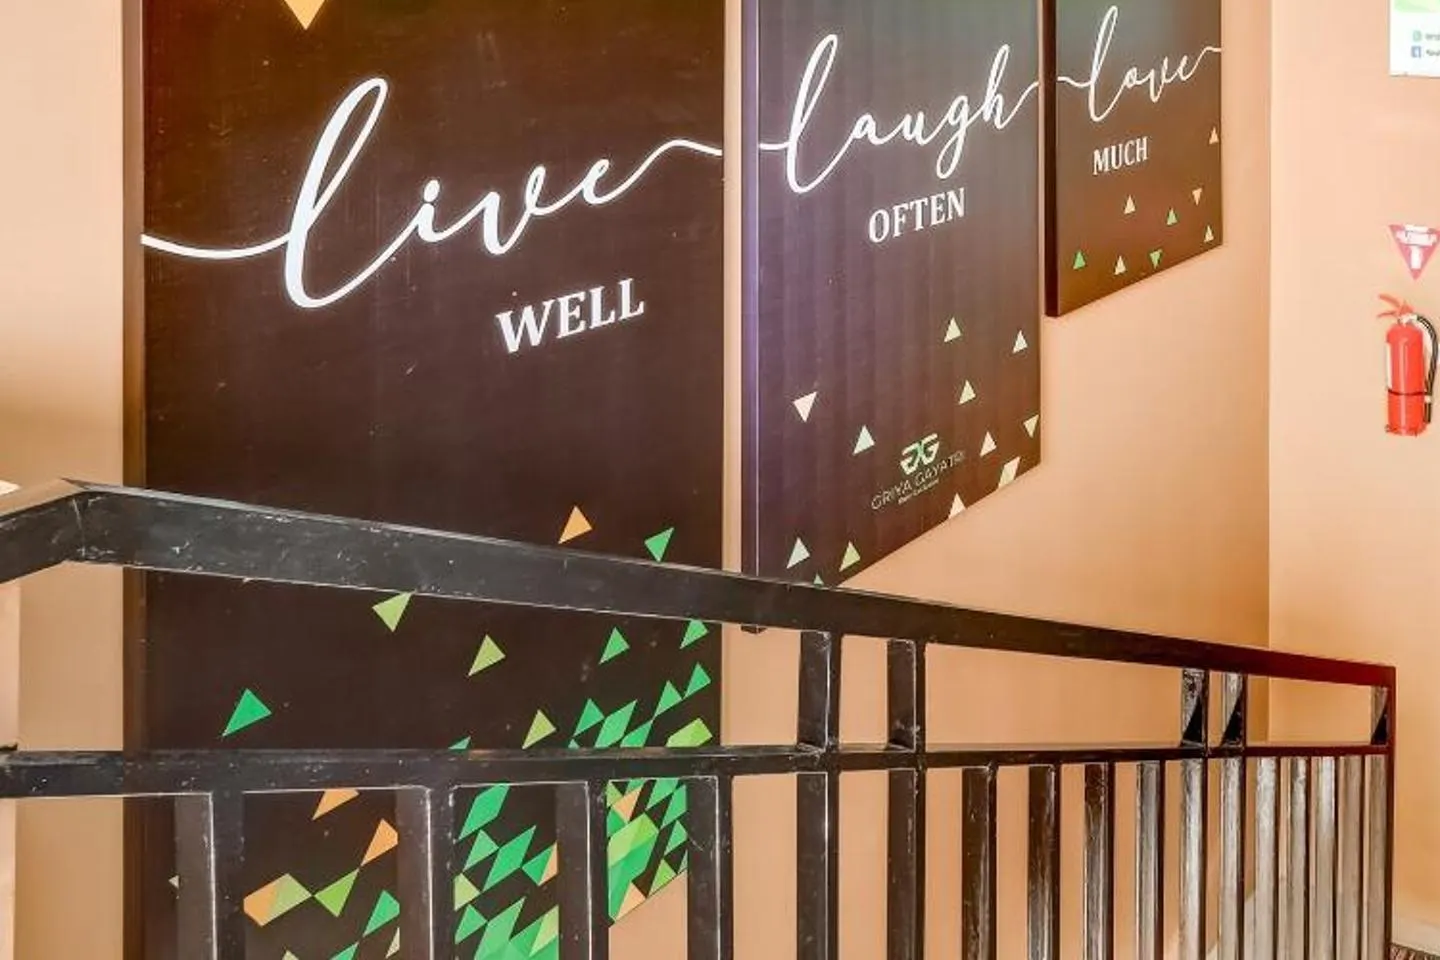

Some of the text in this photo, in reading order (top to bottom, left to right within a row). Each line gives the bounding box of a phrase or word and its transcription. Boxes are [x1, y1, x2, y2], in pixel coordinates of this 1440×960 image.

[1057, 5, 1222, 122] love
[759, 34, 1039, 194] laugh
[1092, 136, 1148, 177] MUCH
[142, 77, 722, 308] live
[868, 187, 967, 244] OFTEN
[496, 278, 645, 354] WELL
